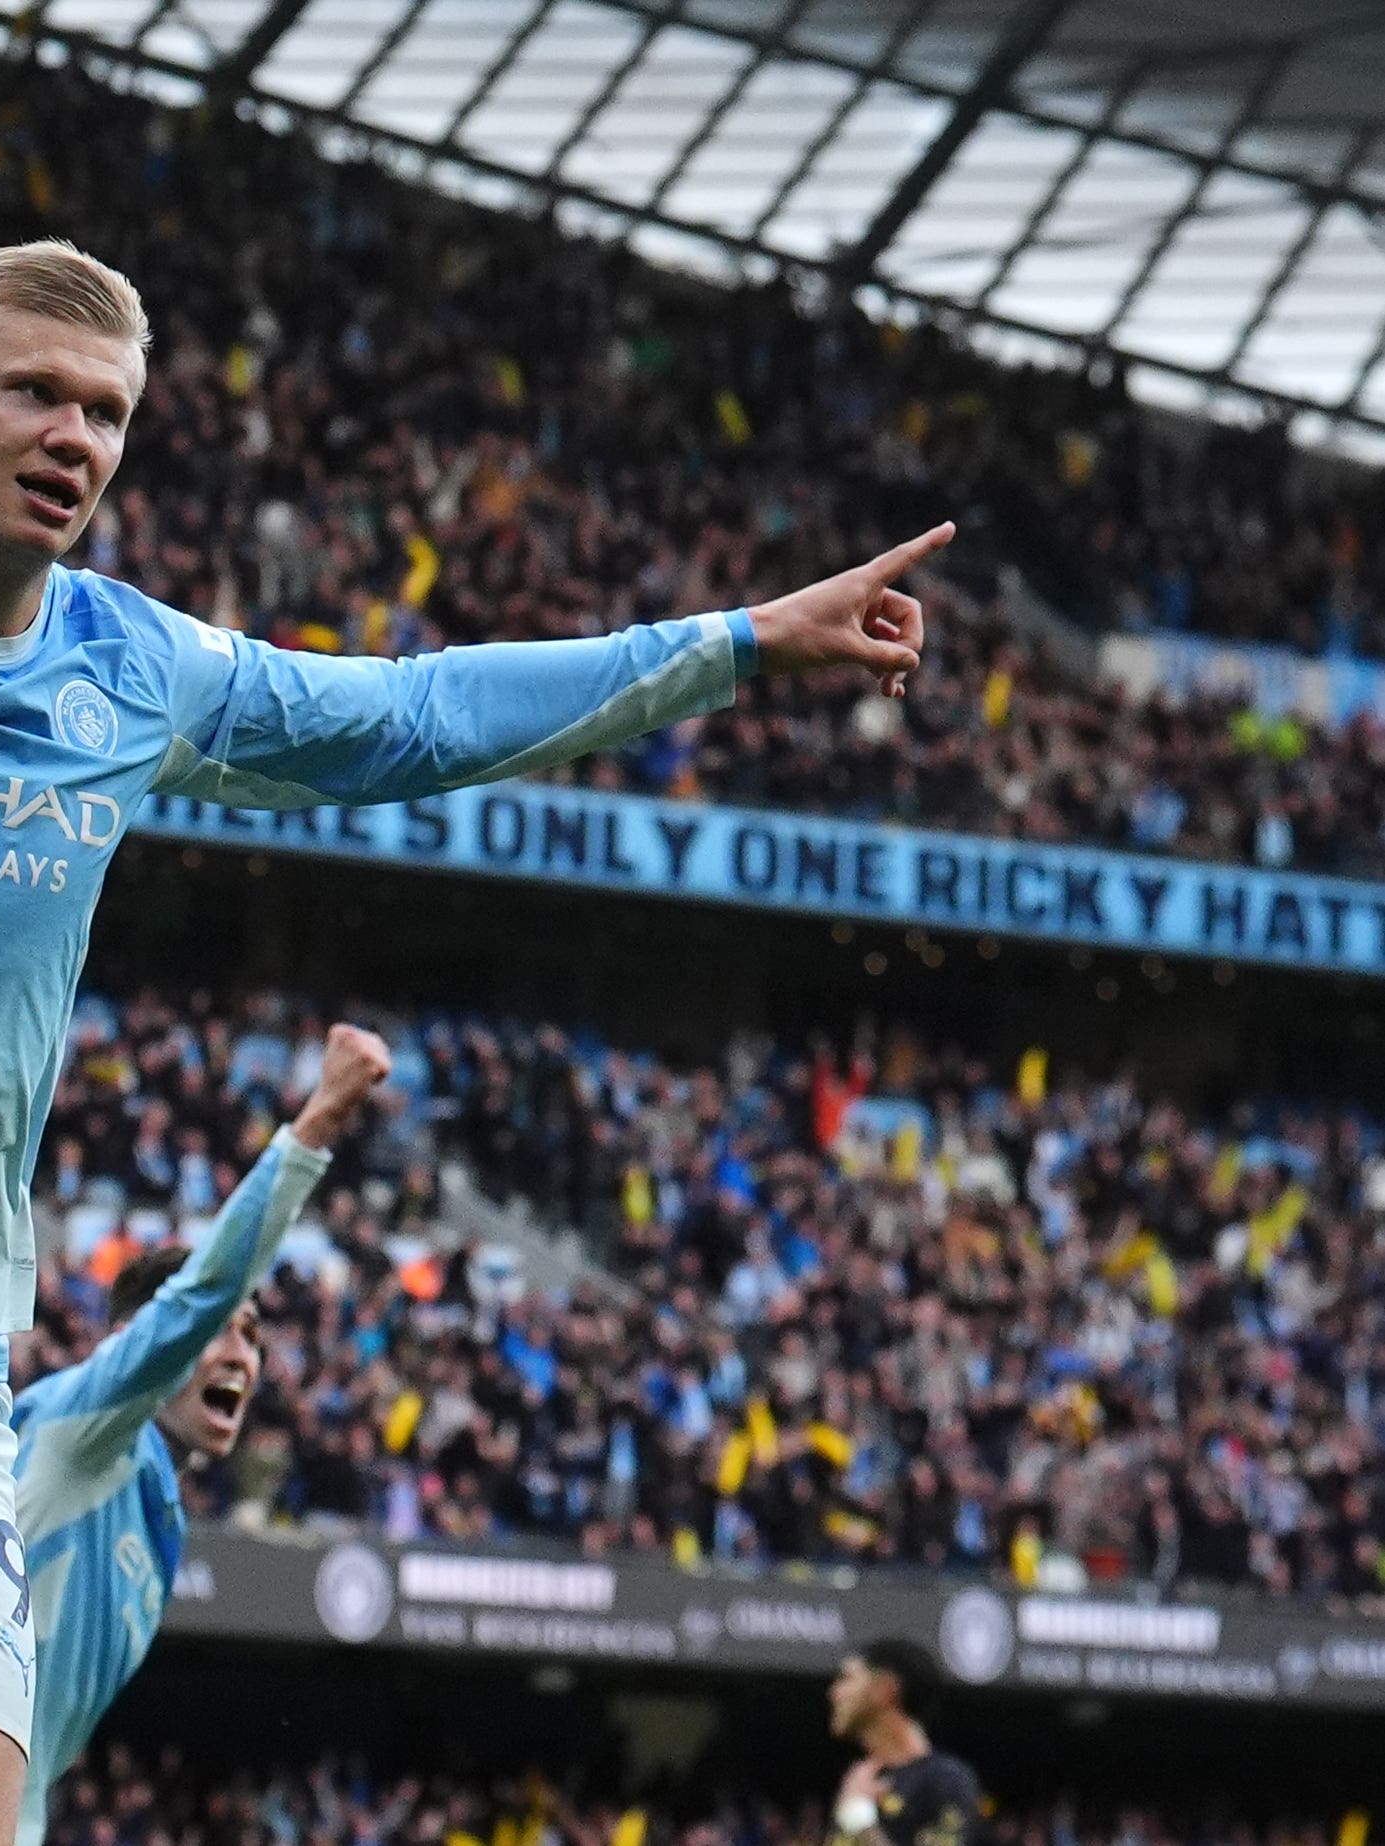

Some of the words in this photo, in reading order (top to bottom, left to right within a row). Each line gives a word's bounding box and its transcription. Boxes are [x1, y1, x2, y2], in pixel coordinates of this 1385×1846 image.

[478, 796, 700, 882] ONLY
[733, 827, 890, 902] ONE
[918, 852, 1172, 933] RICKY
[1202, 882, 1385, 953] HAT
